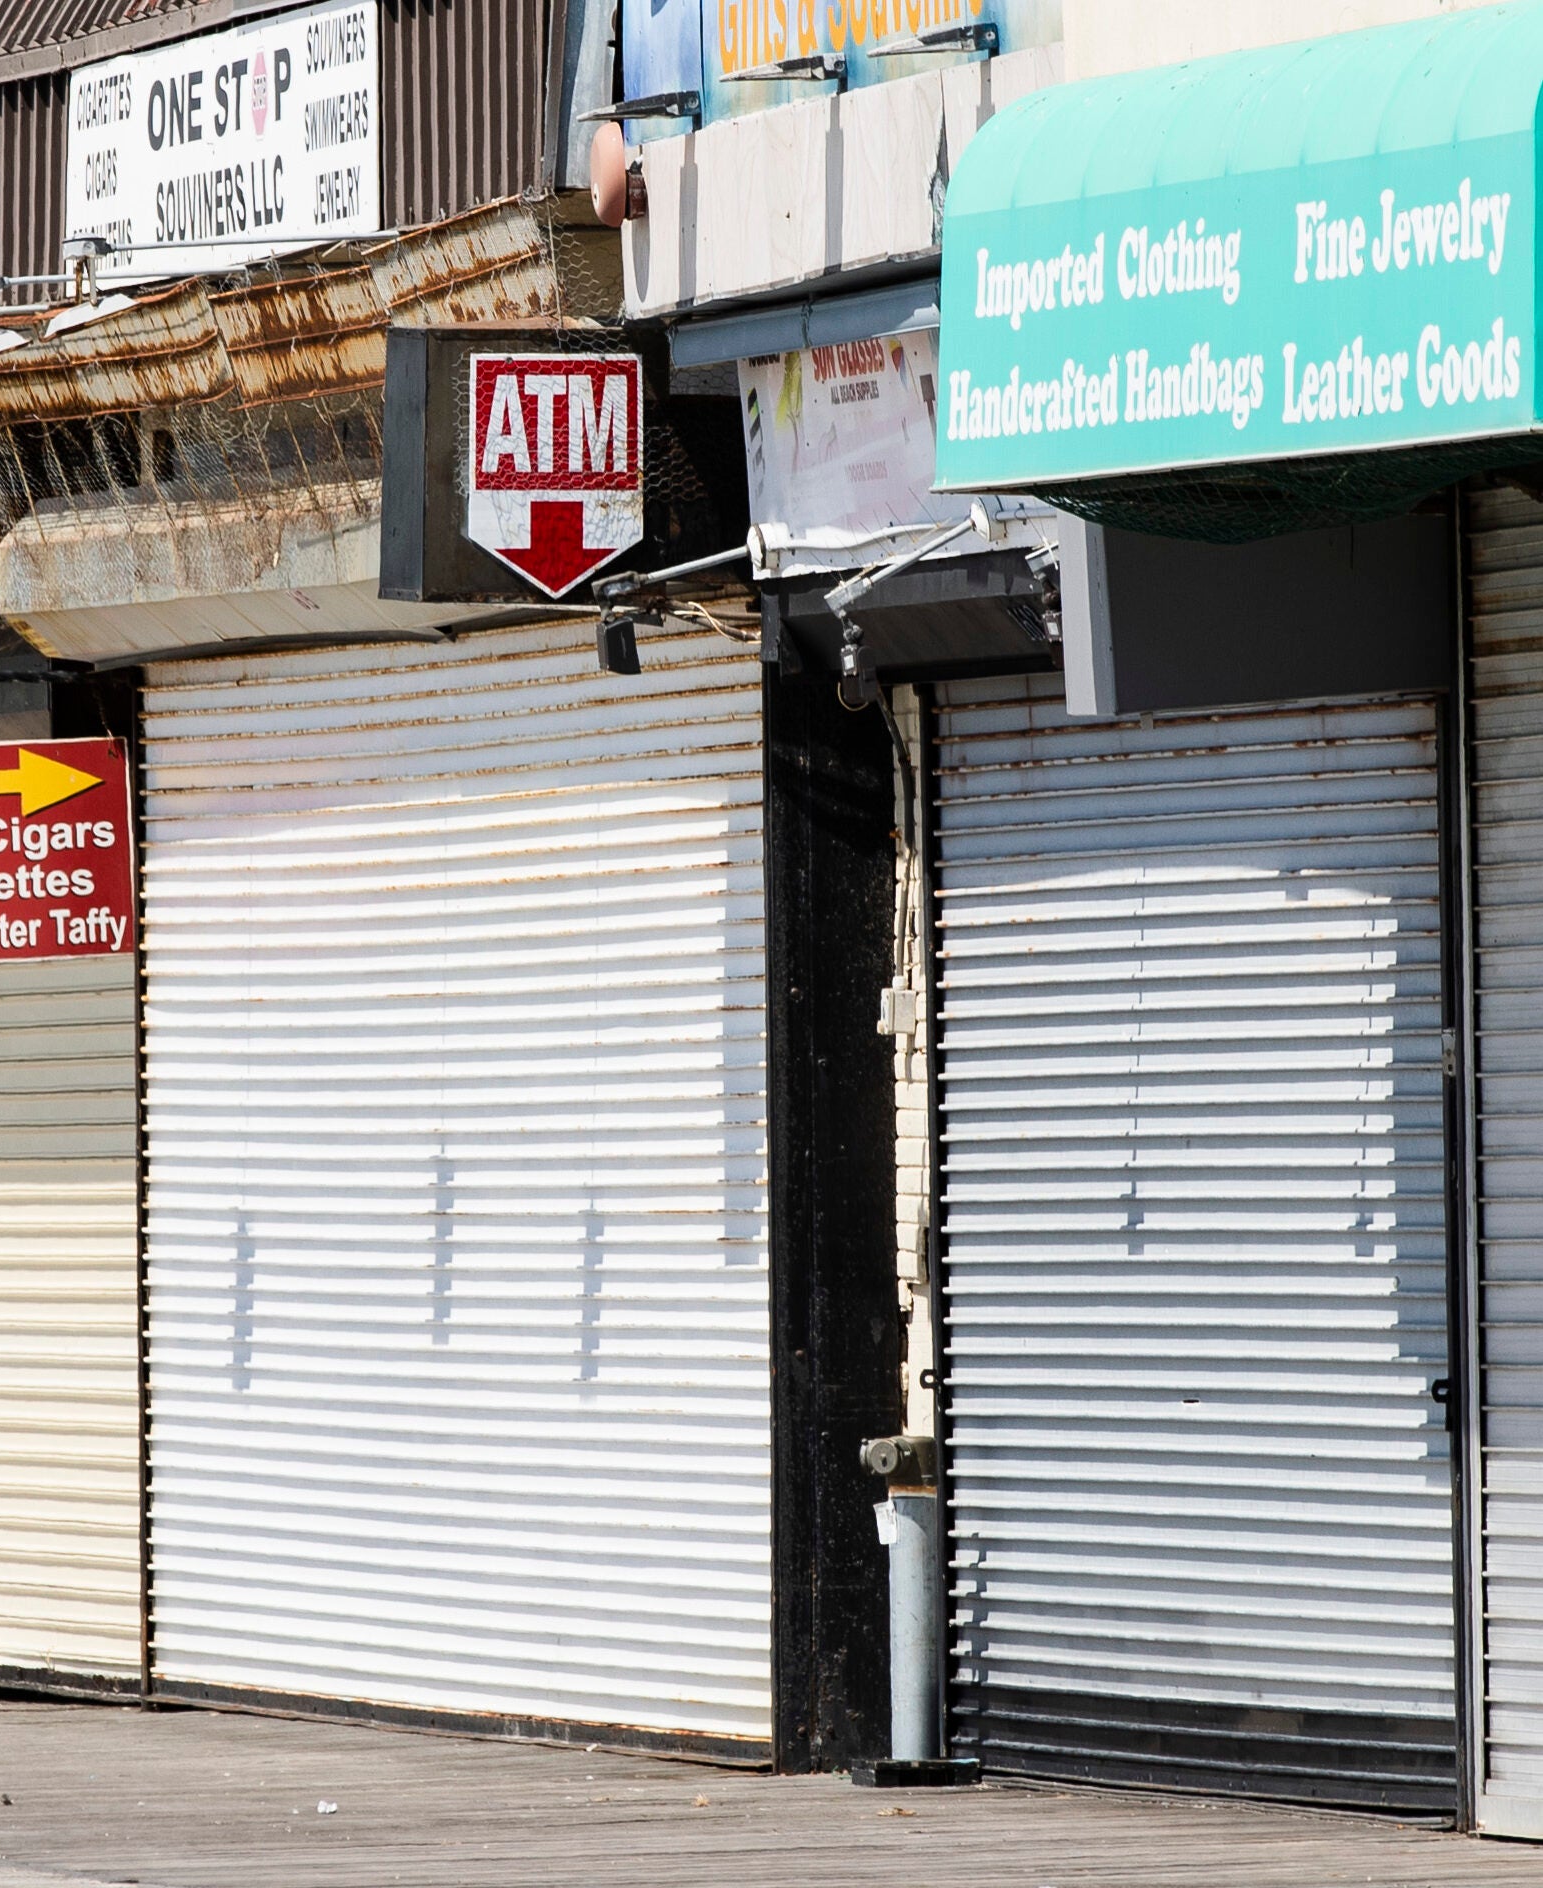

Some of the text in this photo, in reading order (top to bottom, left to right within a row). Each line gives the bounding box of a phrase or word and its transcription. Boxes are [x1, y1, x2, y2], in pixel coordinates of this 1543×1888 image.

[306, 10, 365, 74] SOUVINERS
[76, 71, 132, 131] CIGARETTES
[147, 70, 203, 151] ONE
[305, 88, 368, 153] SWIMWEARS
[85, 148, 117, 201] CIGARS
[156, 154, 284, 241] SOUVINERS LLC
[313, 165, 361, 225] JEWELRY
[1293, 177, 1511, 284] Fine Jewelry
[975, 217, 1242, 330] Imported Clothing
[811, 338, 886, 382] SUN GLASSES
[947, 342, 1265, 442] Handcrafted Handbags
[1282, 317, 1520, 424] Leather Goods
[481, 374, 628, 473] ATM
[49, 906, 127, 951] Taffy
